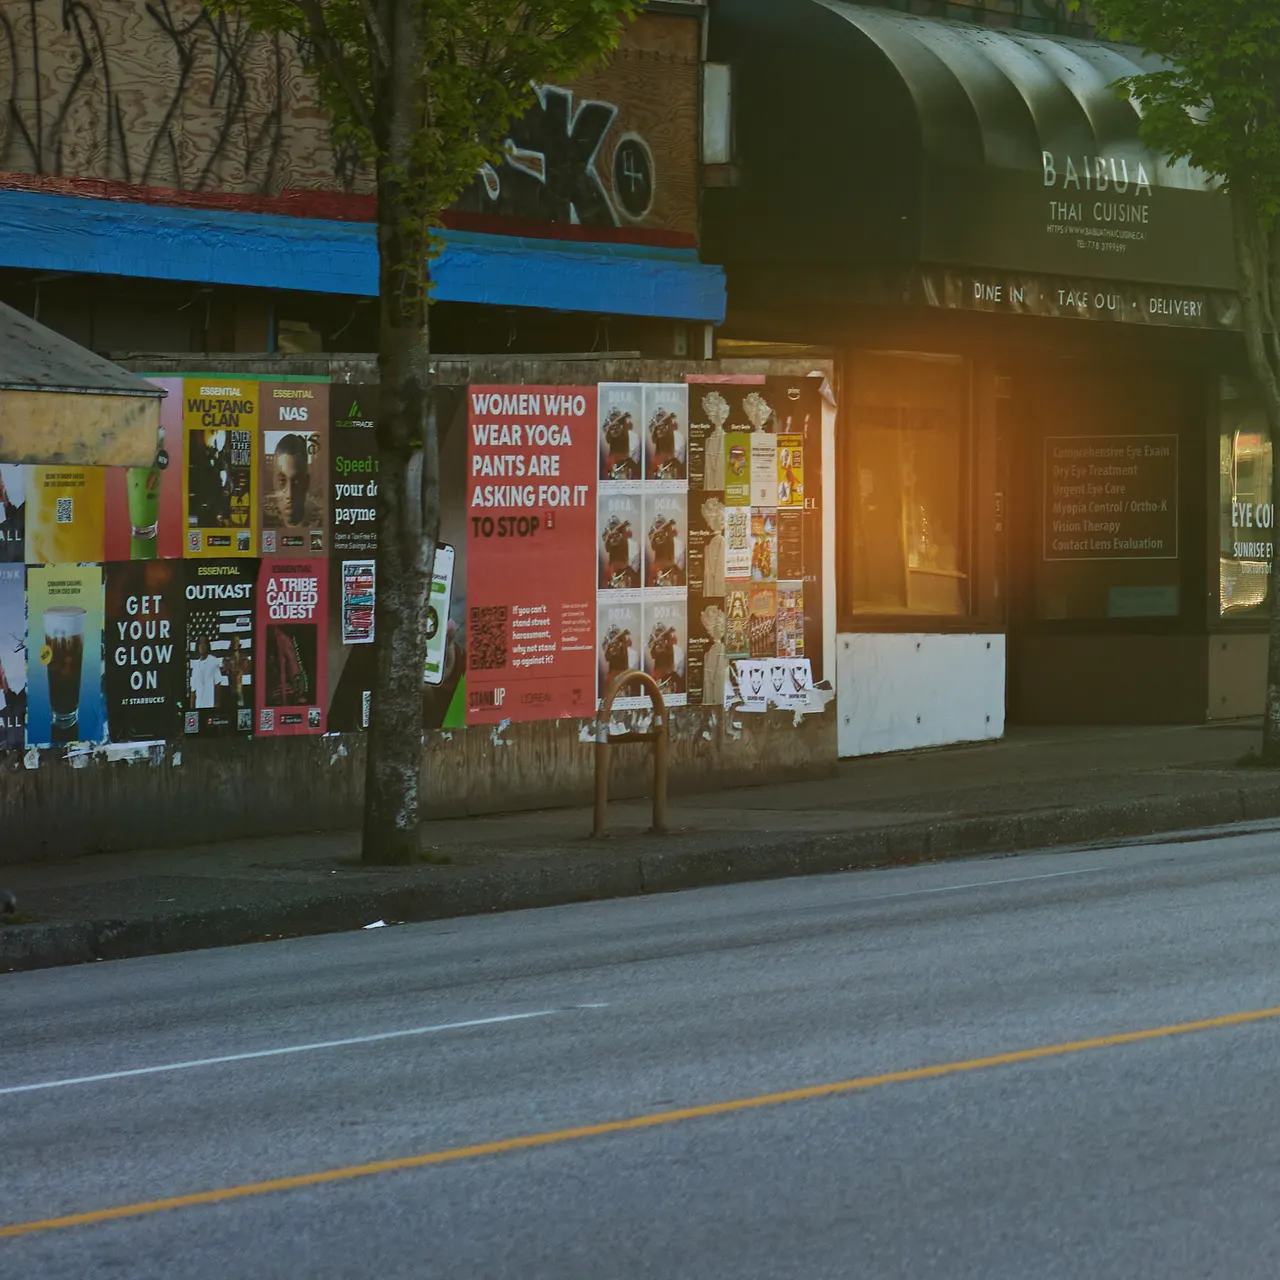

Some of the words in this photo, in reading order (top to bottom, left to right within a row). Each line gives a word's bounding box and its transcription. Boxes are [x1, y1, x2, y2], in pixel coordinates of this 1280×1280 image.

[1041, 149, 1152, 197] BAIBUA
[1050, 201, 1082, 222] THAI
[1093, 202, 1149, 224] CUISINE
[974, 282, 1002, 302] DINE
[1010, 285, 1025, 303] IN
[1058, 289, 1090, 309] TAKE
[1149, 298, 1204, 317] DELIVERY
[200, 386, 242, 397] ESSENTIAL
[273, 389, 314, 399] ESSENTIAL
[188, 399, 254, 415] WU-TANG
[472, 393, 540, 415] WOMEN
[544, 393, 586, 416] WHO
[201, 413, 240, 427] CLAN
[279, 407, 308, 420] NAS
[472, 424, 522, 446] WEAR
[524, 424, 572, 446] YOGA
[1053, 446, 1124, 460] Comprehensive
[1127, 446, 1143, 459] Eye
[1145, 445, 1170, 457] Exam
[336, 456, 373, 476] Speed
[473, 454, 525, 477] PANTS
[528, 455, 560, 477] ARE
[1053, 464, 1069, 478] Dry
[1071, 464, 1087, 478] Eye
[1089, 464, 1139, 476] Treatment
[335, 483, 365, 500] your
[471, 485, 536, 508] ASKING
[538, 485, 571, 508] FOR
[573, 485, 588, 507] IT
[1053, 483, 1085, 497] Urgent
[1087, 483, 1103, 496] Eye
[1105, 483, 1126, 494] Care
[1053, 503, 1086, 516] Myopia
[1089, 501, 1122, 512] Control
[1130, 500, 1168, 512] Ortho-K
[1231, 502, 1253, 528] EYE
[335, 508, 377, 525] payme
[471, 516, 494, 538] TO
[498, 516, 540, 538] STOP
[1053, 521, 1081, 532] Vision
[1083, 520, 1121, 534] Therapy
[1052, 538, 1088, 551] Contact
[1090, 538, 1112, 550] Lens
[1113, 537, 1163, 550] Evaluation
[1233, 541, 1265, 558] SUNRISE
[198, 566, 240, 576] ESSENTIAL
[272, 565, 312, 574] ESSENTIAL
[185, 583, 252, 601] OUTKAST
[267, 578, 278, 591] A
[279, 578, 318, 591] TRIBE
[126, 595, 163, 616] GET
[266, 591, 318, 606] CALLED
[269, 605, 315, 619] QUEST
[117, 620, 170, 641] YOUR
[512, 618, 530, 627] stand
[531, 618, 550, 626] street
[538, 642, 556, 651] stand
[115, 644, 174, 666] GLOW
[130, 670, 158, 691] ON
[130, 696, 166, 705] STARBUCKS
